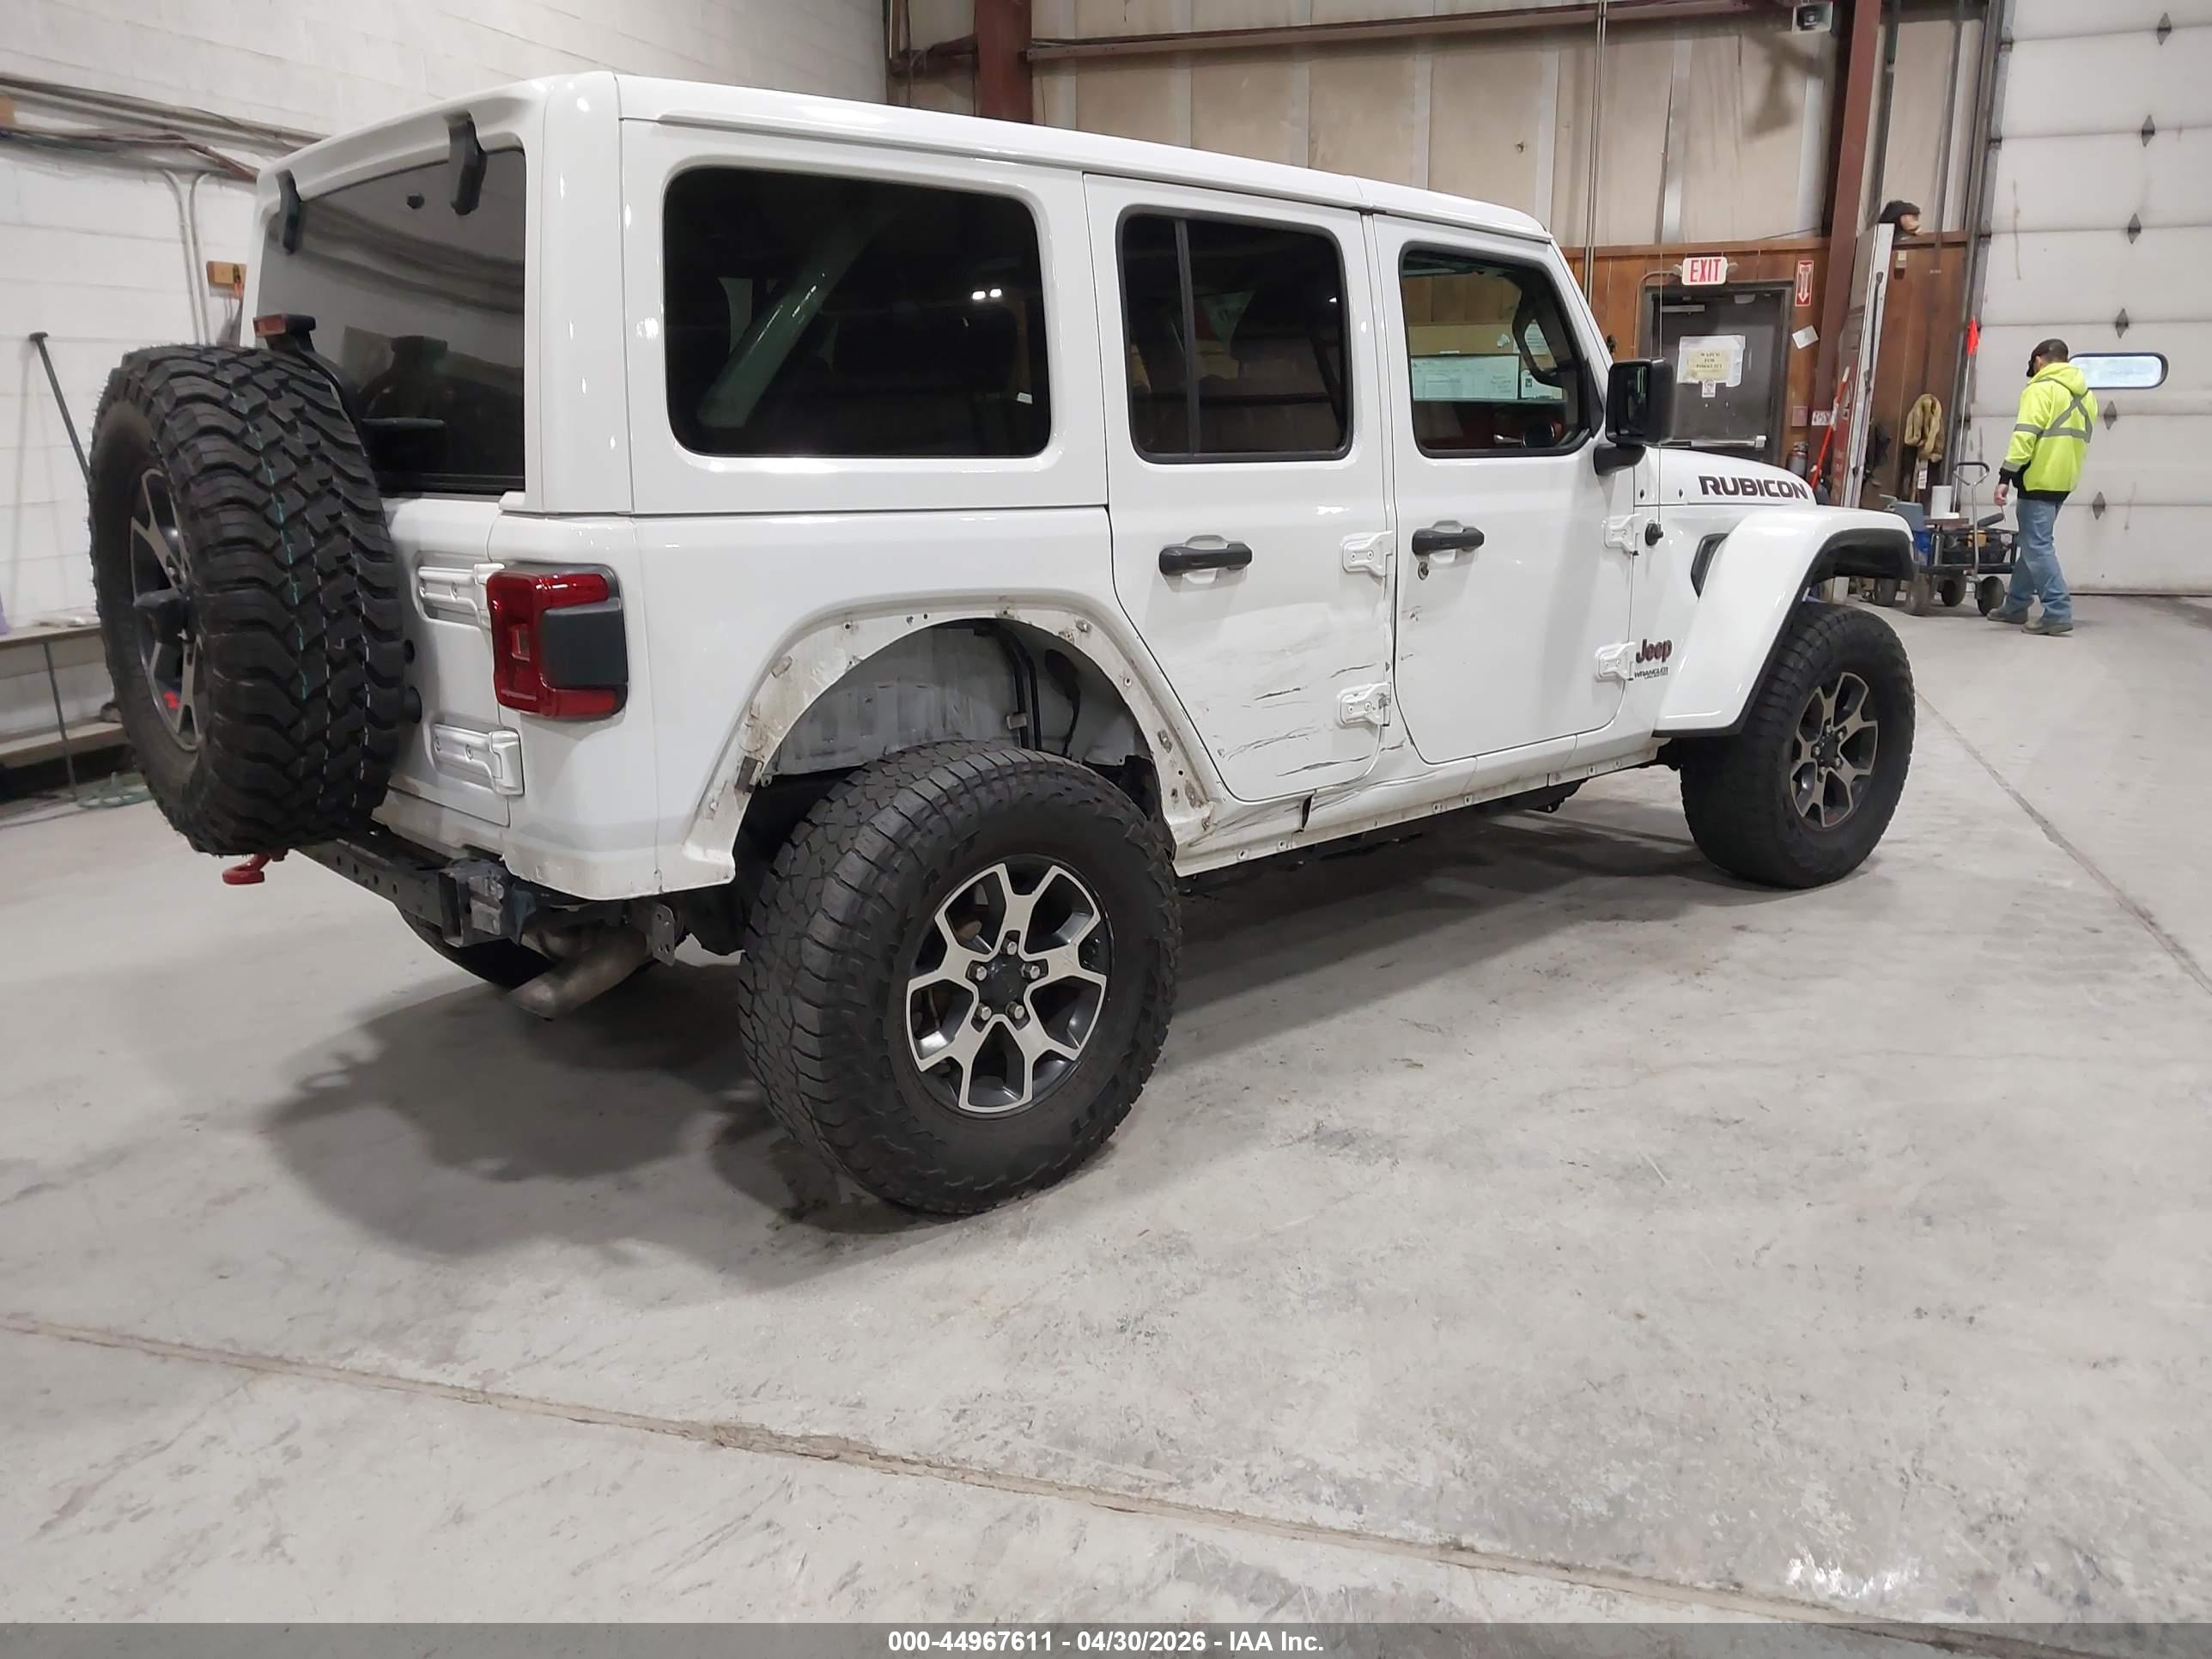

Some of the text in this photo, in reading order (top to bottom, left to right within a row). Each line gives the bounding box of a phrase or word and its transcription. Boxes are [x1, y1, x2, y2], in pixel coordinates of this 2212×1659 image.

[1690, 258, 1721, 283] EXIT
[1698, 476, 1808, 499] RUBICON
[1636, 638, 1673, 663] Jeep
[1634, 666, 1668, 678] WRANGLER
